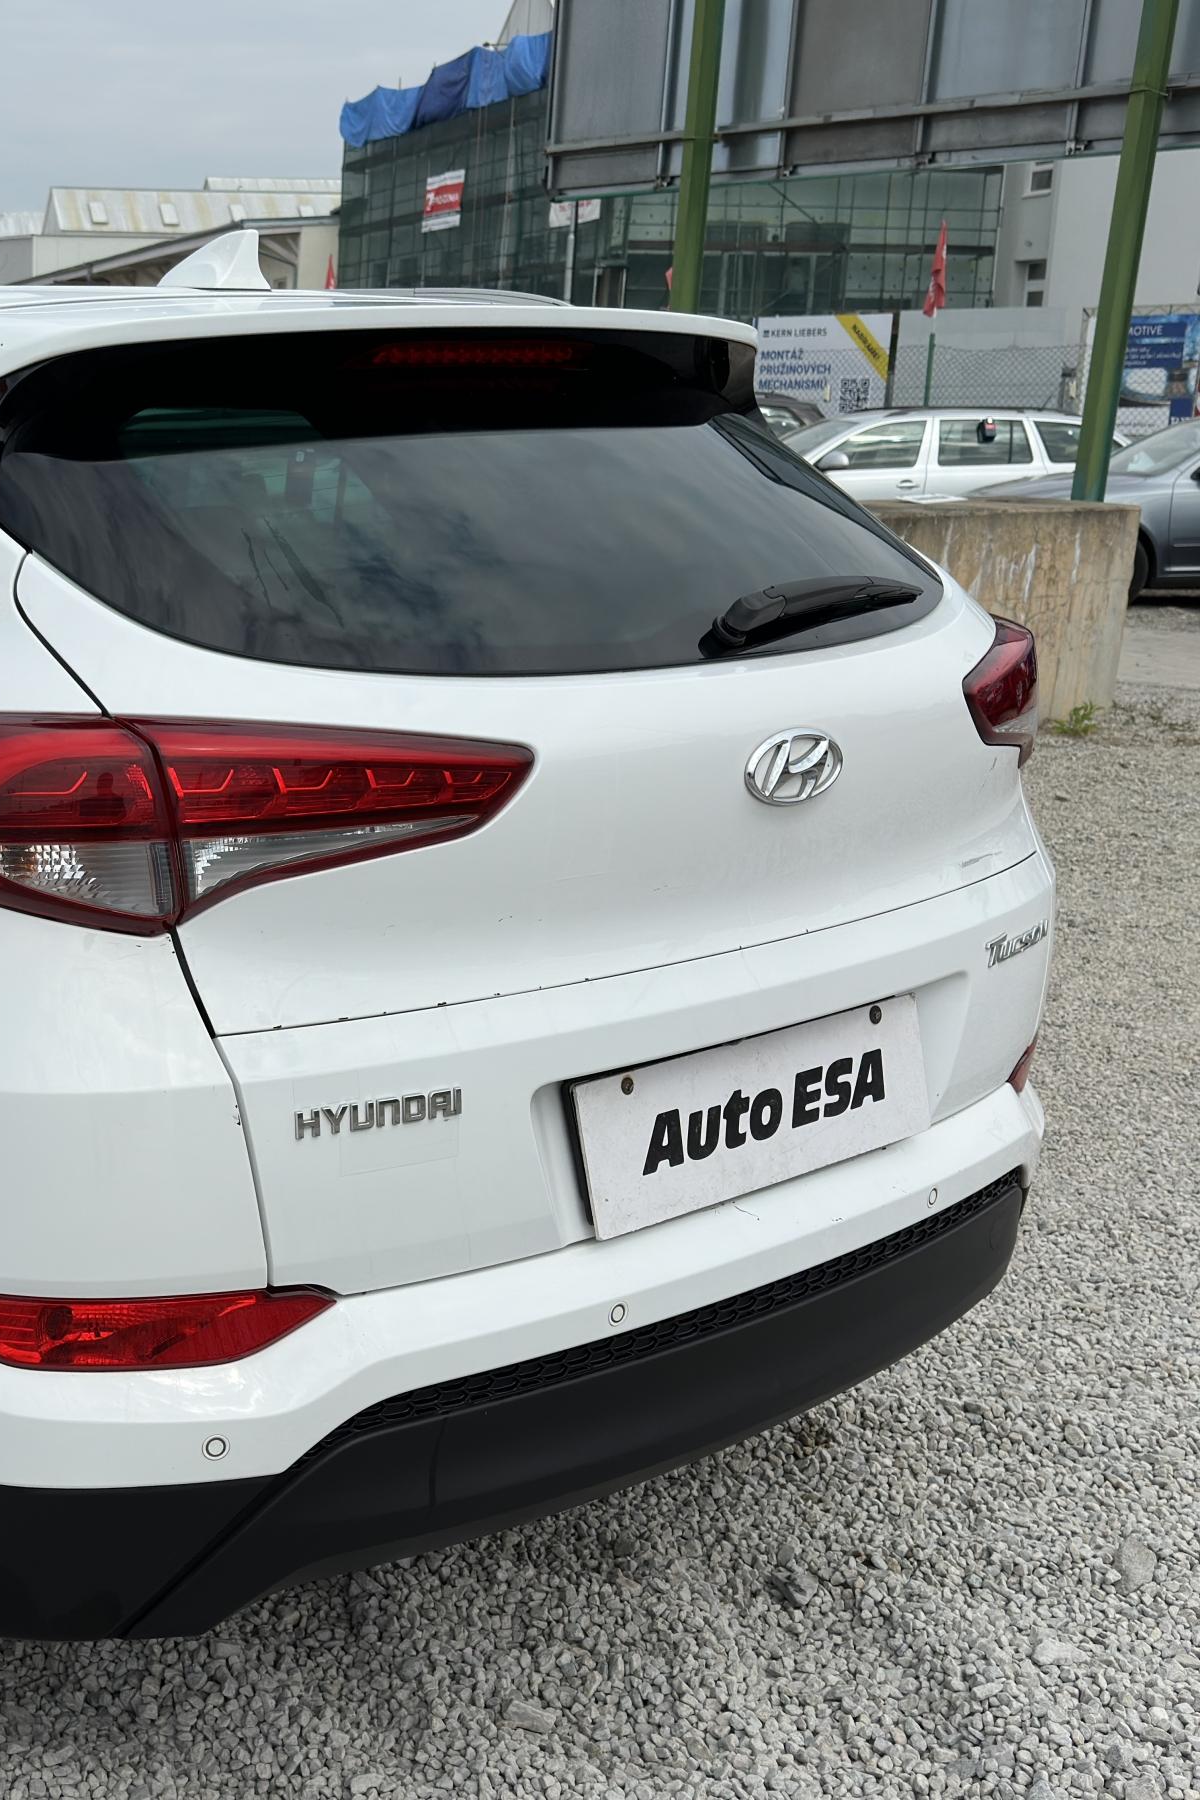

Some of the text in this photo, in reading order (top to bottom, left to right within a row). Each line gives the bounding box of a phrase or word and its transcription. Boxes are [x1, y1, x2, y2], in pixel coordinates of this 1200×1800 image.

[771, 328, 827, 337] KERN LIEBERS
[760, 347, 804, 361] MONTÁŽ
[294, 1086, 463, 1140] HYUNDAI
[642, 1048, 886, 1176] Auto ESA
